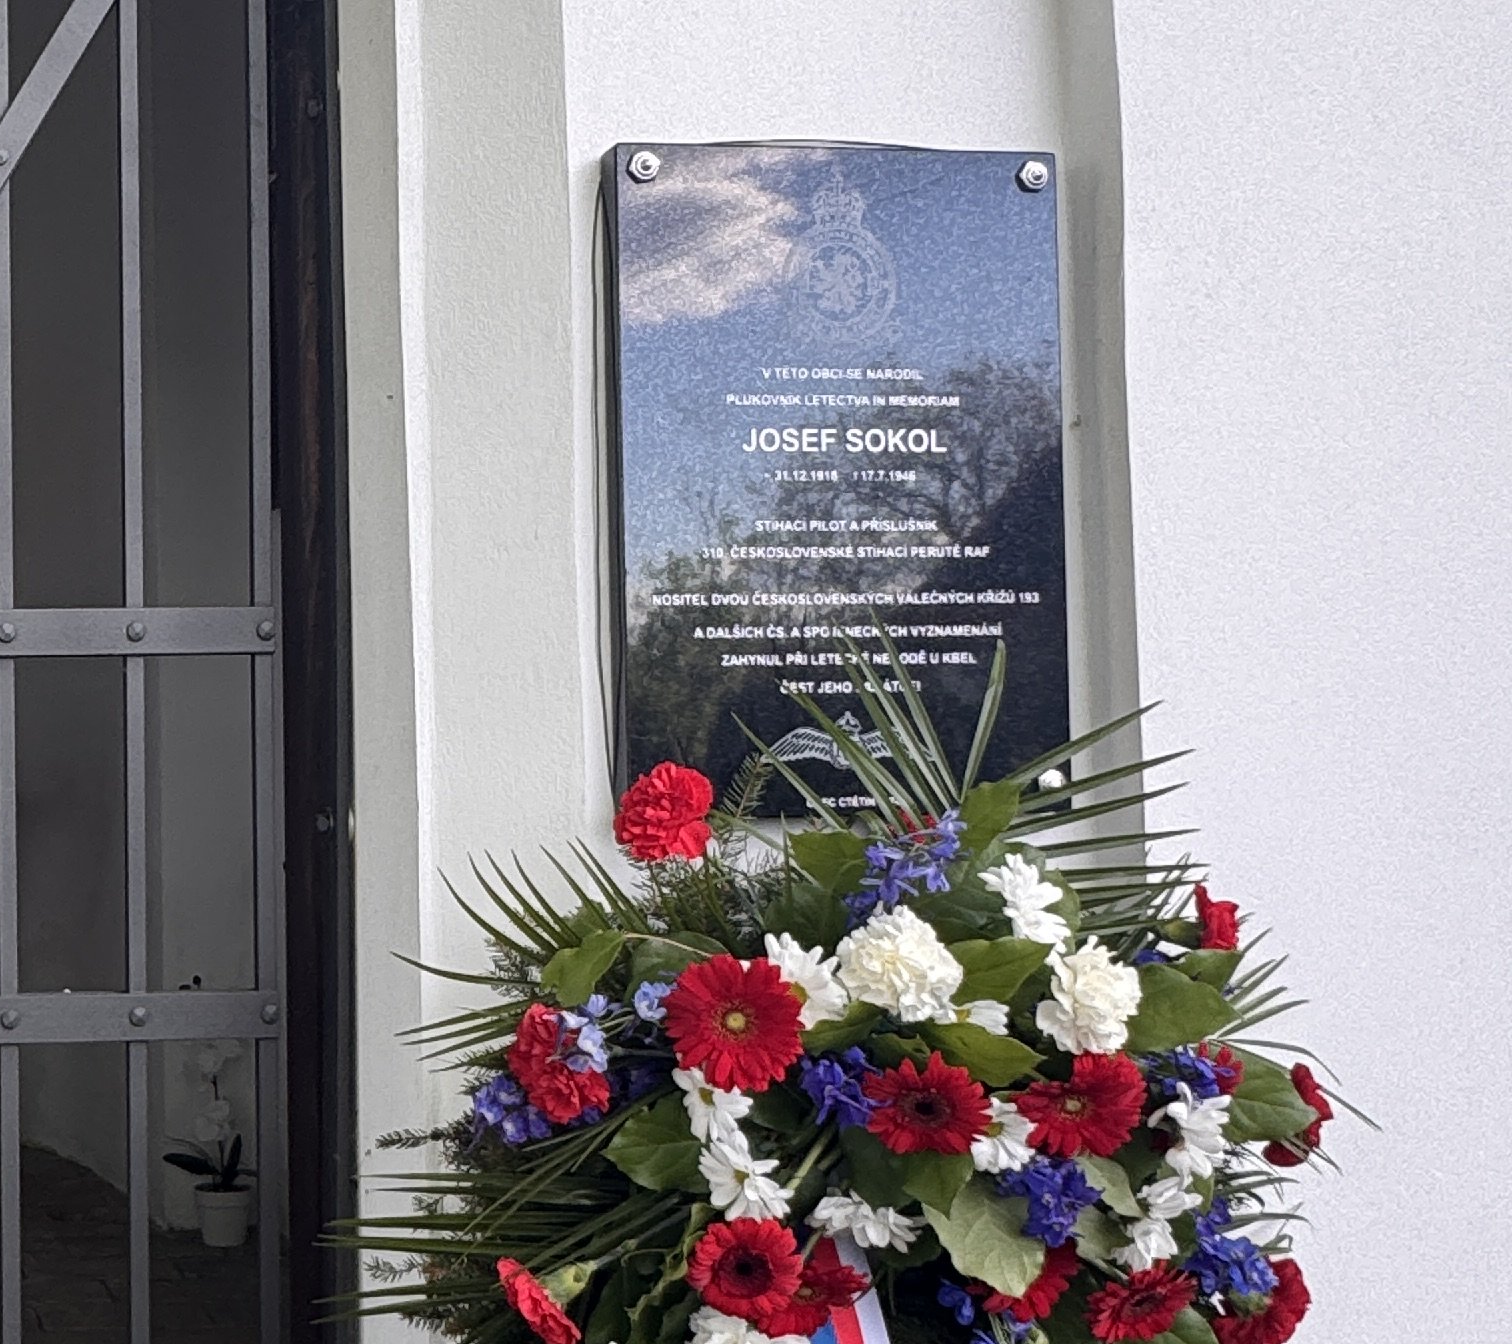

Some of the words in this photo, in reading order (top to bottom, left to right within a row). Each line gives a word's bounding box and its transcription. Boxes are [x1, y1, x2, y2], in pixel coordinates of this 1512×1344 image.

[845, 368, 863, 379] SE
[866, 368, 923, 380] NARODIL
[804, 394, 869, 406] LETECTVA
[872, 394, 885, 406] IN
[888, 394, 960, 406] MEMORIAM
[742, 427, 837, 452] JOSEF
[845, 427, 948, 453] SOKOL
[809, 520, 847, 532] PILOT
[849, 520, 859, 531] A
[730, 544, 853, 558] ČESKOSLOVENSKÉ
[964, 546, 990, 558] RAF
[652, 594, 709, 606] NOSITEL
[711, 594, 749, 606] DVOU
[752, 590, 894, 606] ČESKOSLOVENSKÝCH
[694, 626, 704, 639] A
[791, 626, 801, 638] A
[910, 622, 1002, 636] VYZNAMENÁNÍ
[721, 654, 783, 666] ZAHYNUL
[786, 651, 808, 666] PŘI
[873, 649, 927, 665] NEODĚ
[930, 652, 939, 664] U
[943, 652, 977, 664] KBEL
[780, 679, 815, 694] ČEST
[817, 681, 853, 694] JEHO
